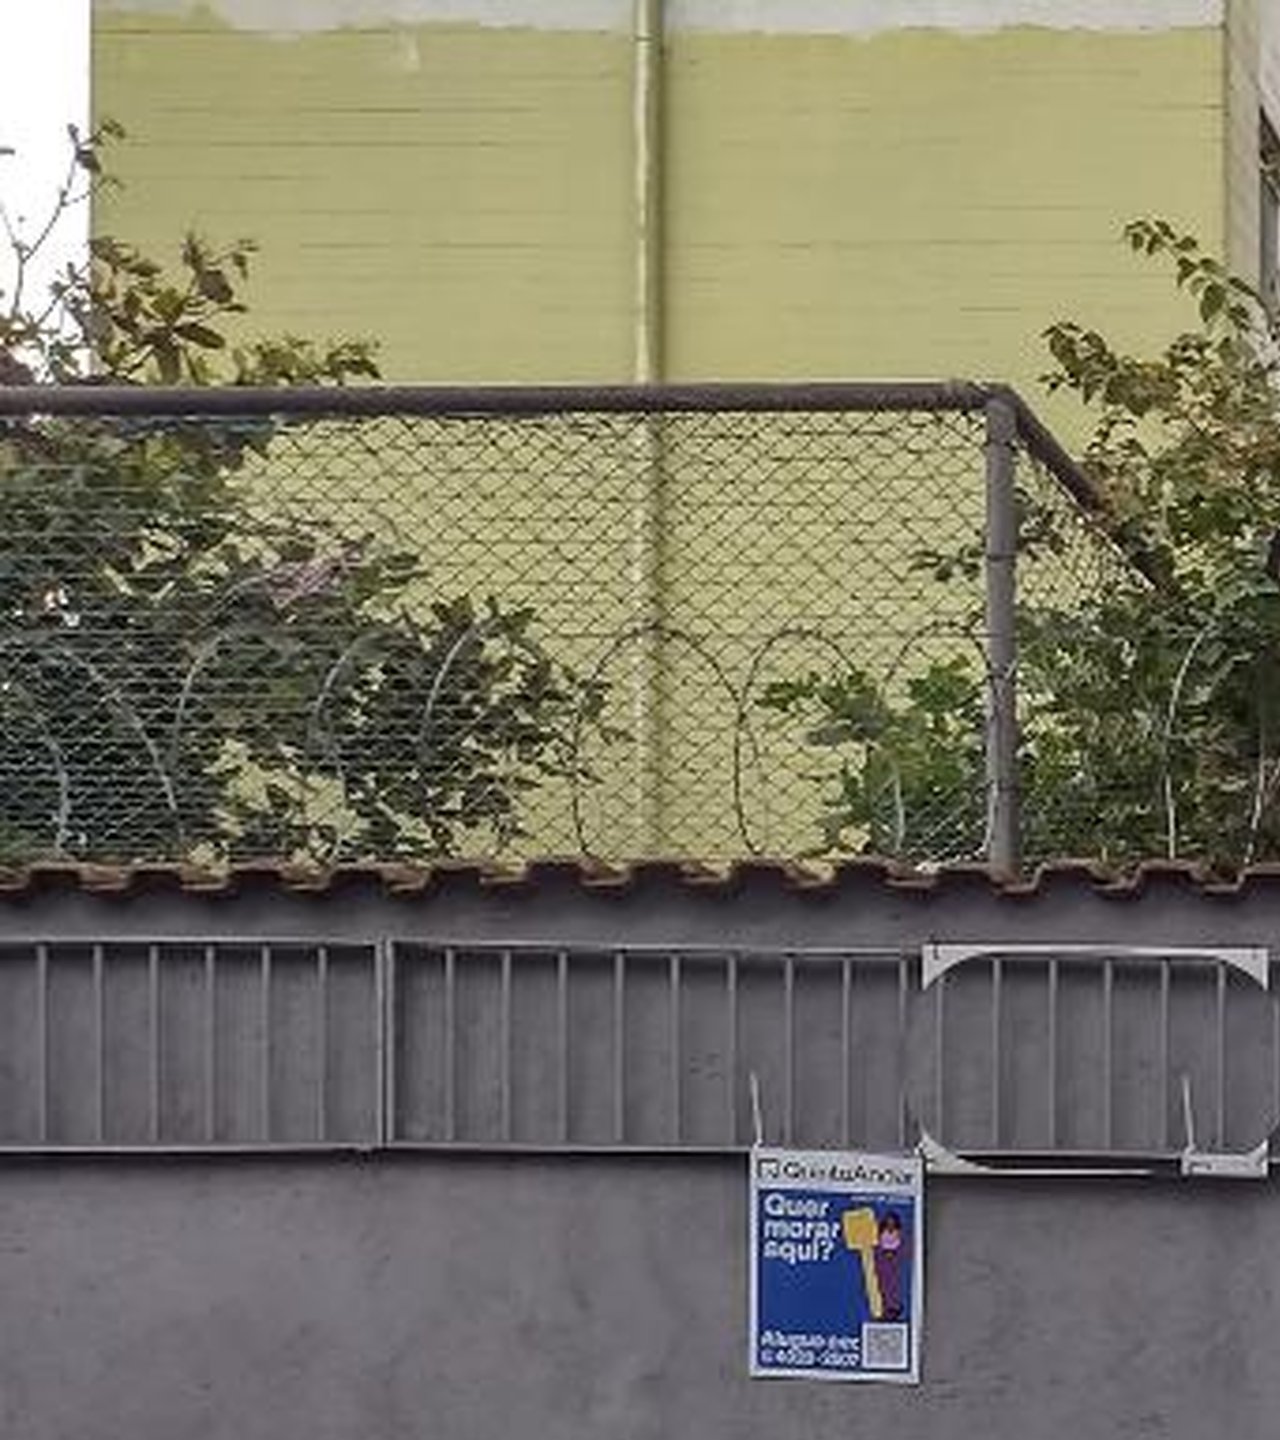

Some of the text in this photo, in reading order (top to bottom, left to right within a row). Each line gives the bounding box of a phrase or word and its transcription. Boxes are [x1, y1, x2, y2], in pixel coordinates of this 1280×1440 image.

[763, 1193, 830, 1218] Quer
[763, 1219, 841, 1239] morar
[763, 1237, 834, 1264] aqui?
